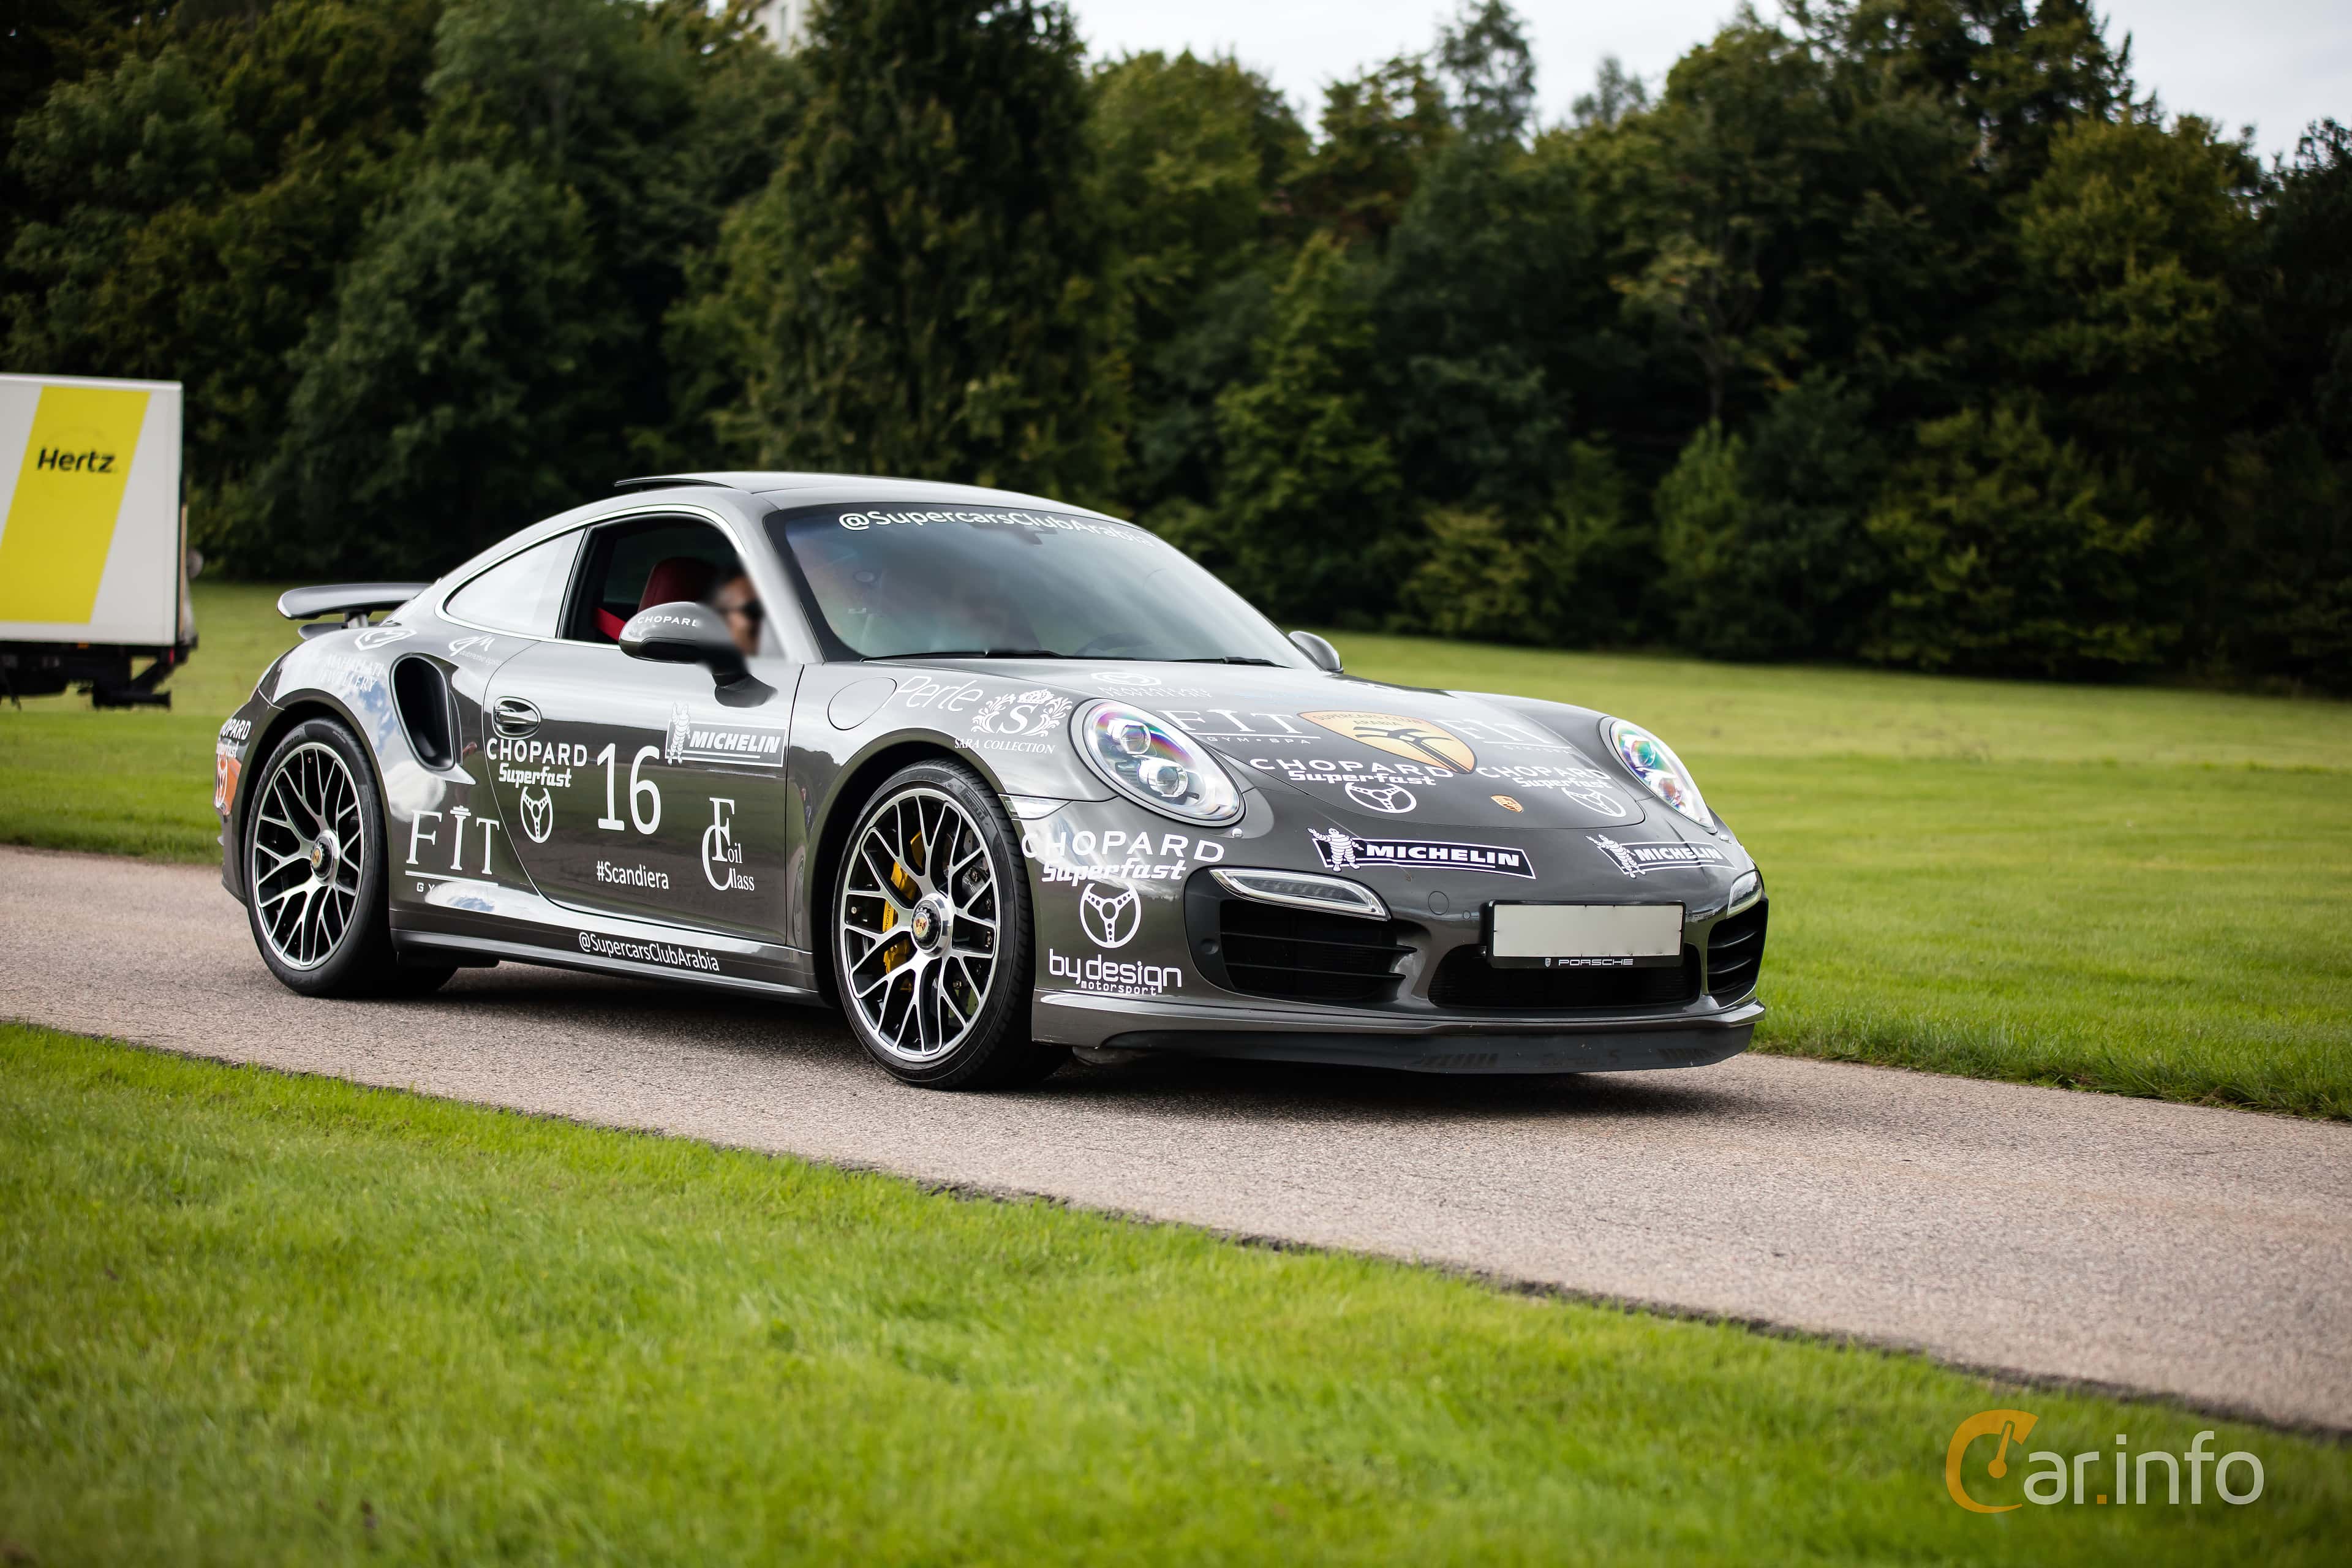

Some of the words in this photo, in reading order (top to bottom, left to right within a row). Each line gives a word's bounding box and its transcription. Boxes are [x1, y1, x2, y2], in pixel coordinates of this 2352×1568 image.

[37, 448, 116, 473] Hertz
[839, 510, 1155, 548] @SupercarsClubArabia
[1156, 709, 1303, 734] FIT
[486, 738, 587, 767] CHOPARD
[690, 730, 781, 753] MICHELIN
[955, 737, 980, 749] SARA
[984, 739, 1056, 754] COLLECTION
[499, 766, 572, 788] Superfast
[1250, 758, 1454, 778] CHOPARD
[1287, 770, 1436, 786] Superfast
[1476, 766, 1612, 780] CHOPARD
[597, 742, 662, 835] 16
[406, 805, 500, 876] FIT
[1021, 830, 1225, 863] CHOPARD
[1366, 844, 1520, 867] MICHELIN
[1636, 846, 1723, 862] MICHELIN
[596, 861, 669, 889] #Scandiera
[1041, 858, 1187, 887] Superfast
[578, 932, 720, 971] @SupercarsClubArabia
[1049, 948, 1081, 984] by
[1080, 979, 1157, 996] motorsport
